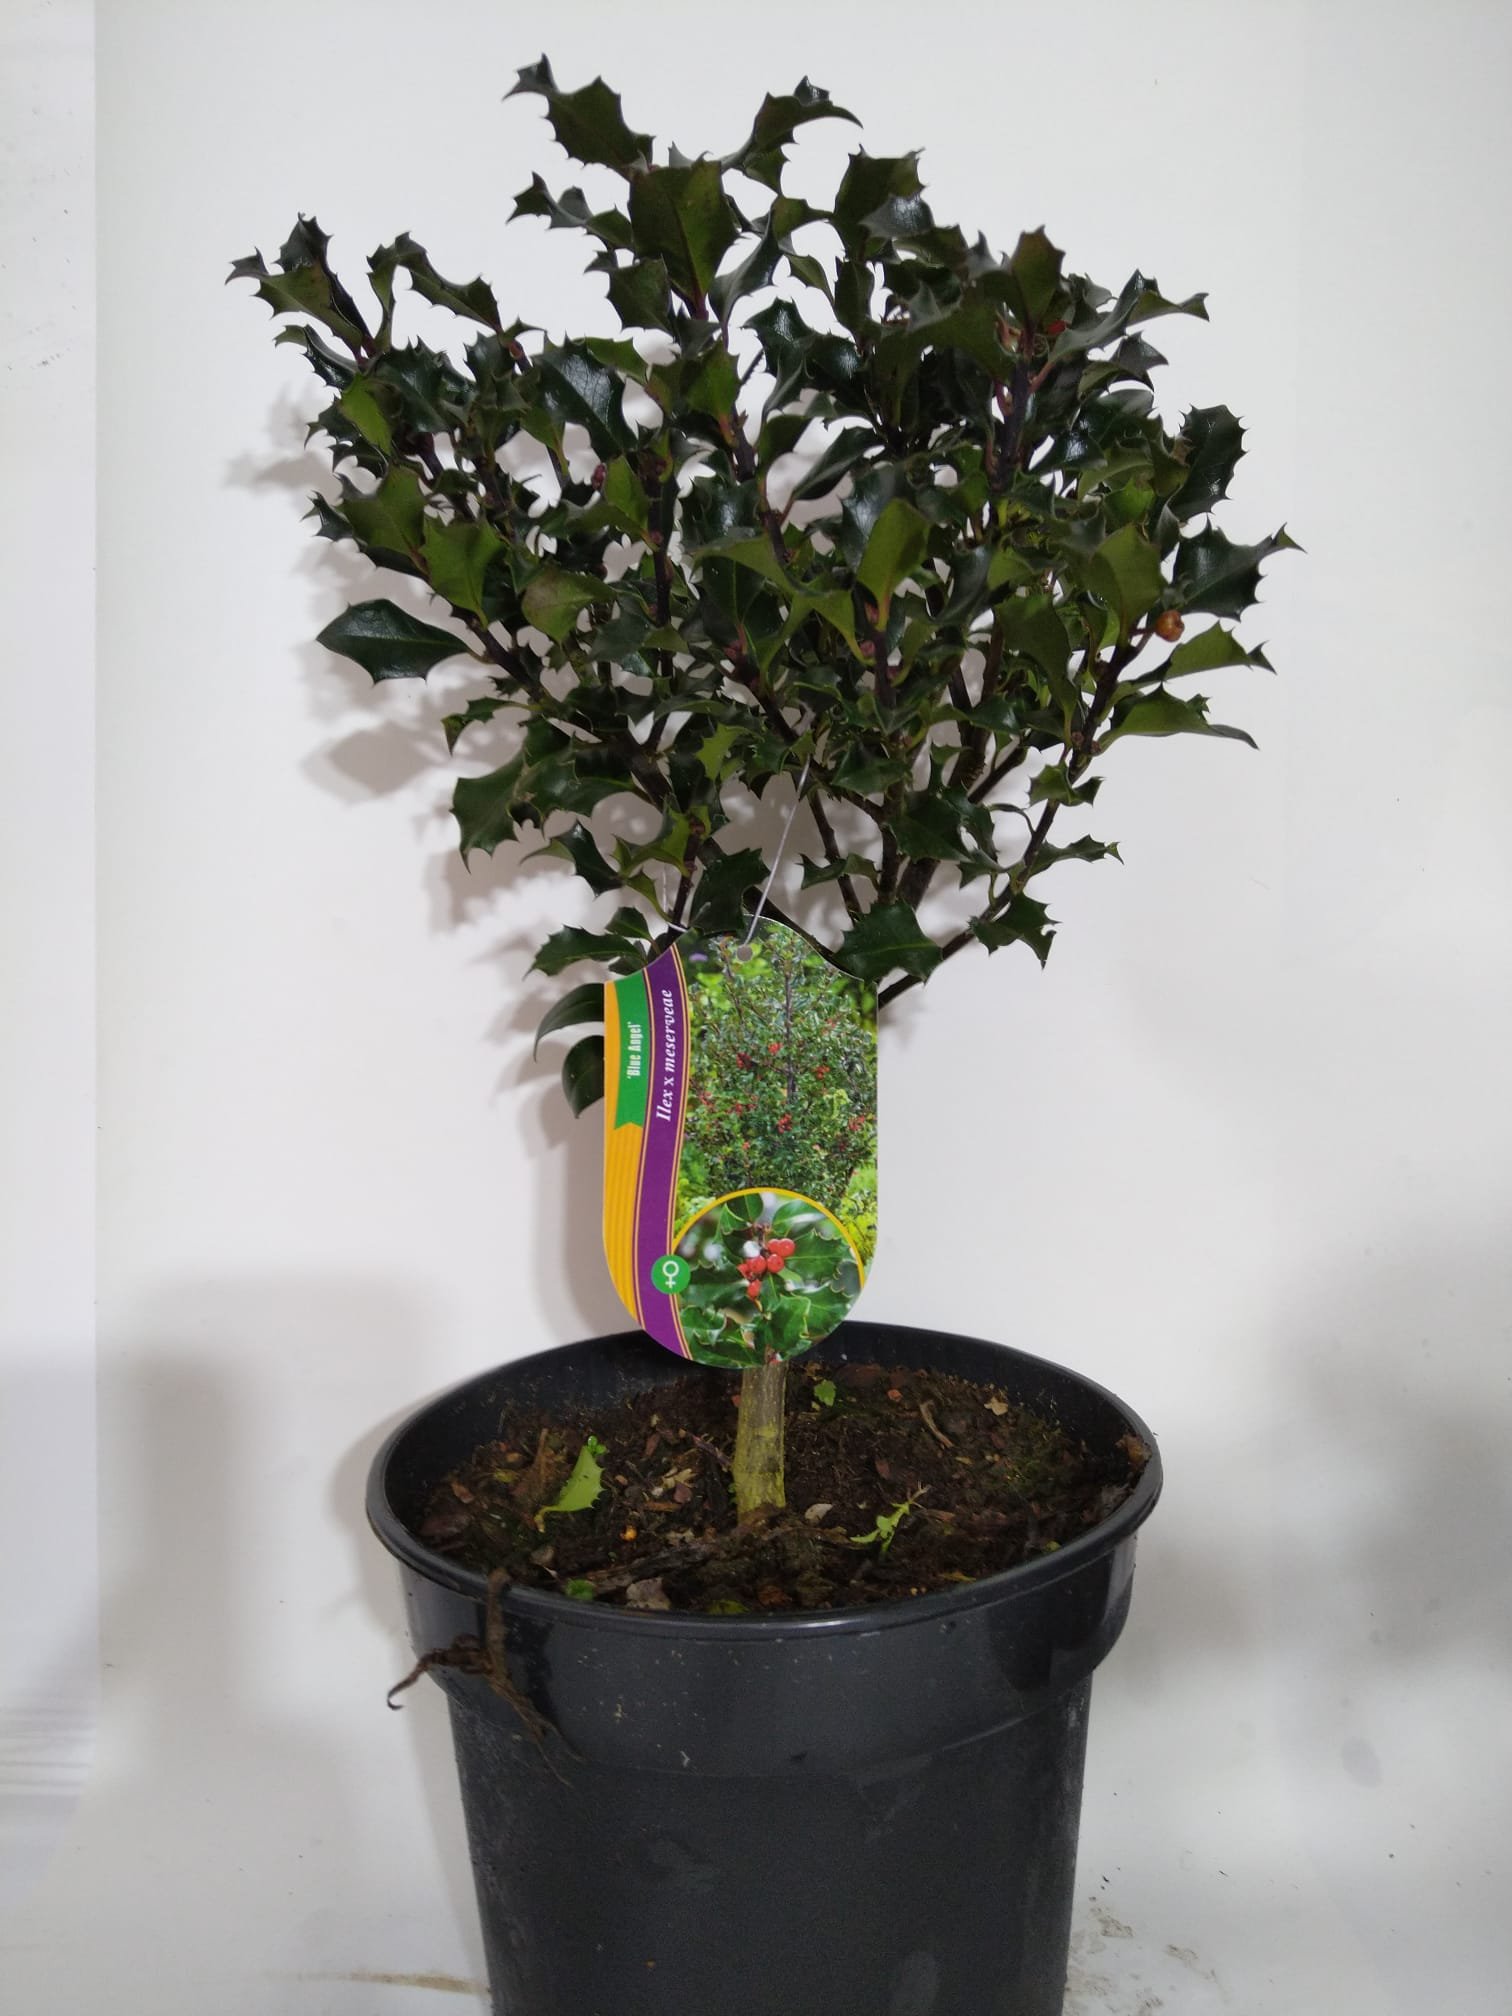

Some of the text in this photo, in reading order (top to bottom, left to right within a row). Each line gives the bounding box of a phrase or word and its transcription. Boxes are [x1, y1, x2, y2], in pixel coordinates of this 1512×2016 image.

[655, 989, 676, 1121] Ilex x meserveae
